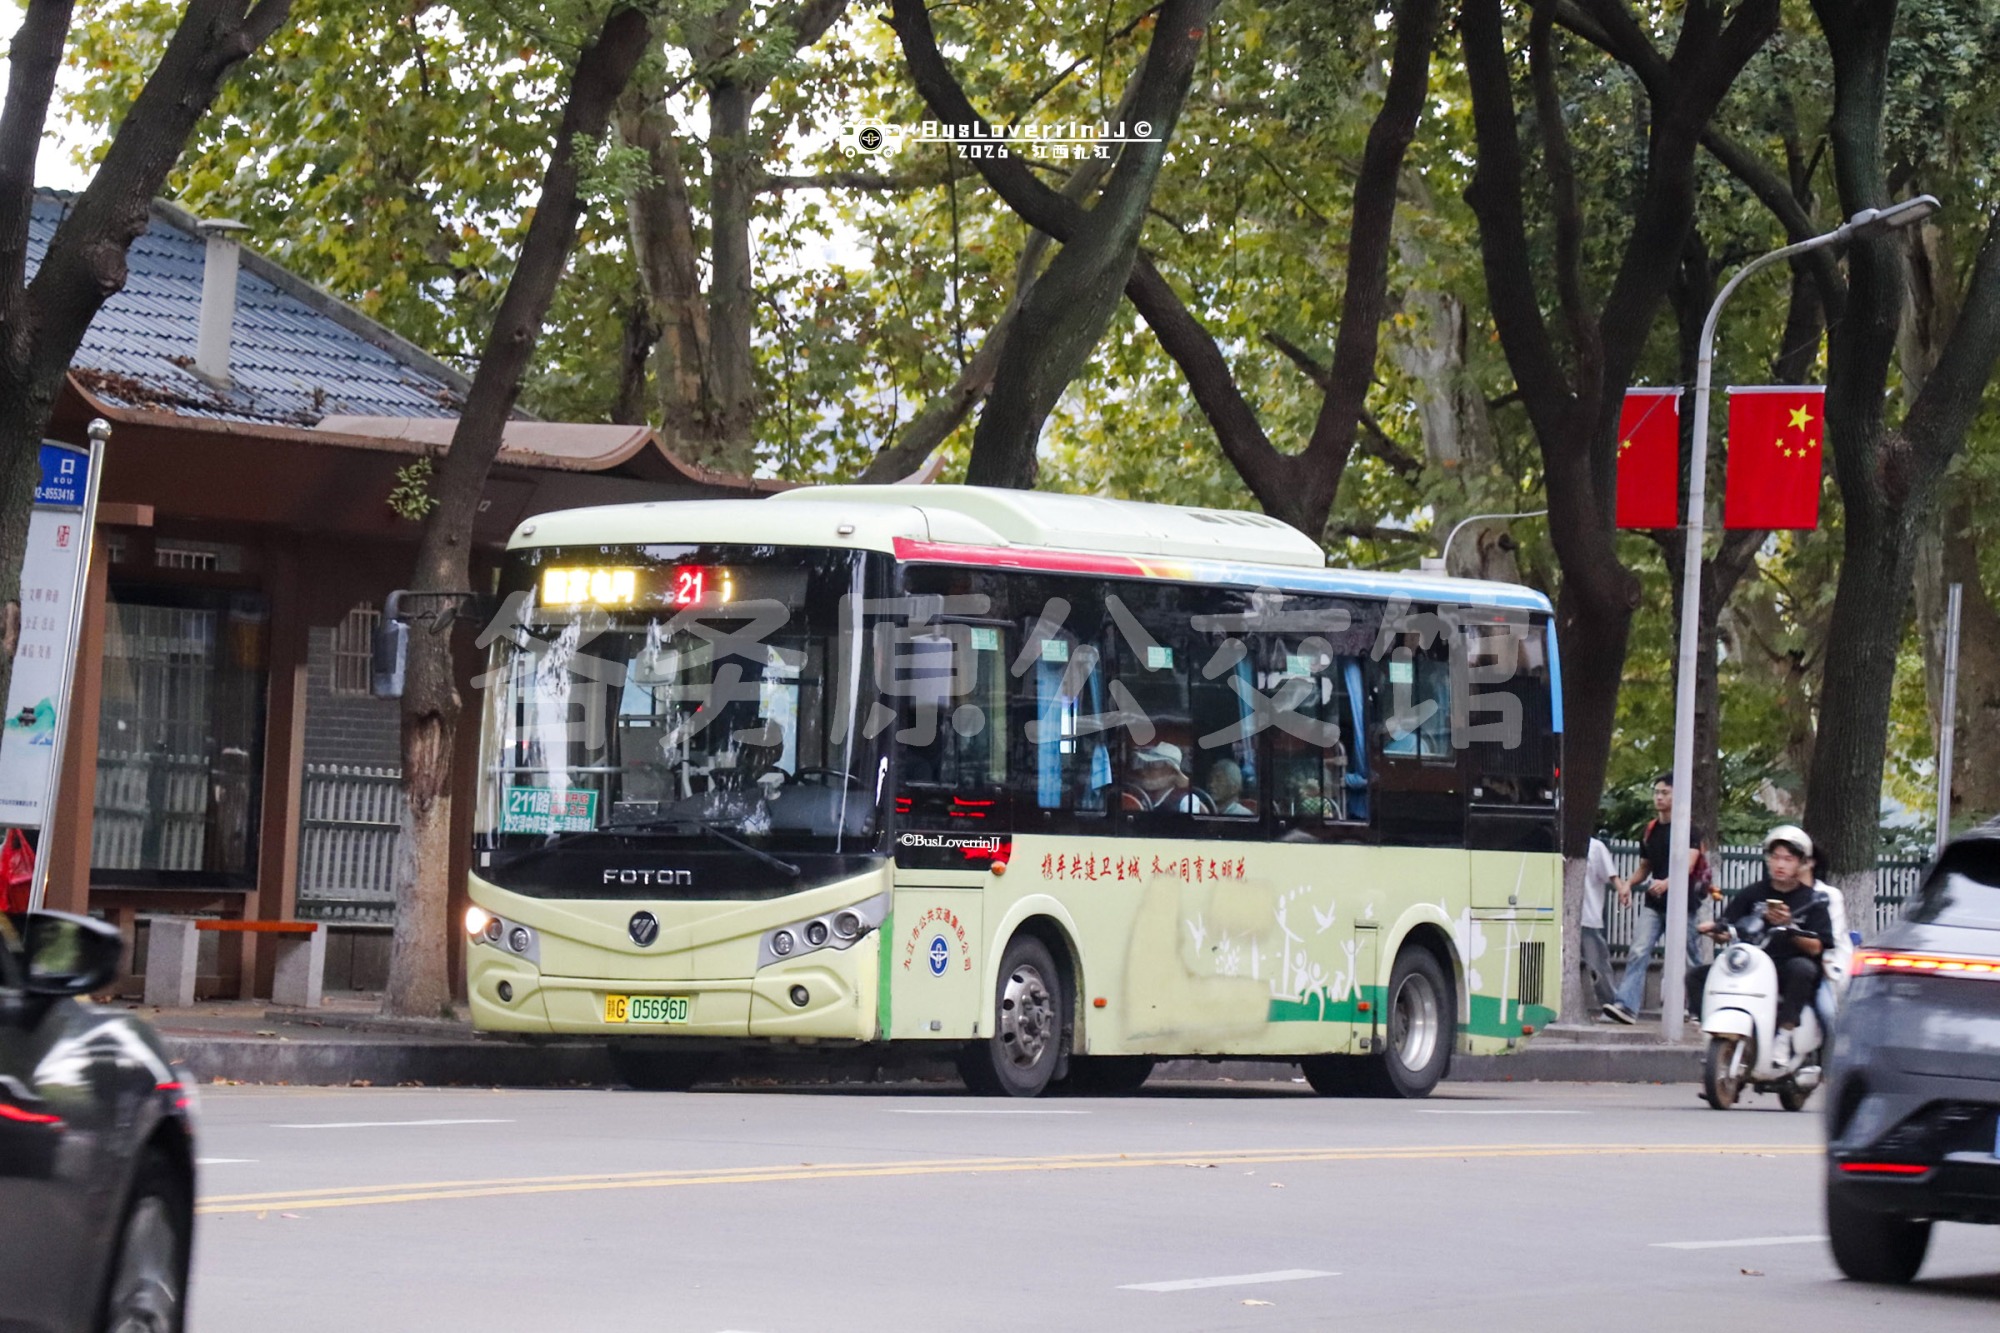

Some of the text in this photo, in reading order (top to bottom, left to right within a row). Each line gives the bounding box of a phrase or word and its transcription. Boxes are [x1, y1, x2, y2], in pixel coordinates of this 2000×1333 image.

[60, 458, 75, 474] 口
[53, 477, 73, 485] KOU
[510, 790, 551, 814] 211路
[1041, 851, 1142, 883] 携手共建卫生城
[603, 868, 692, 886] FOTON
